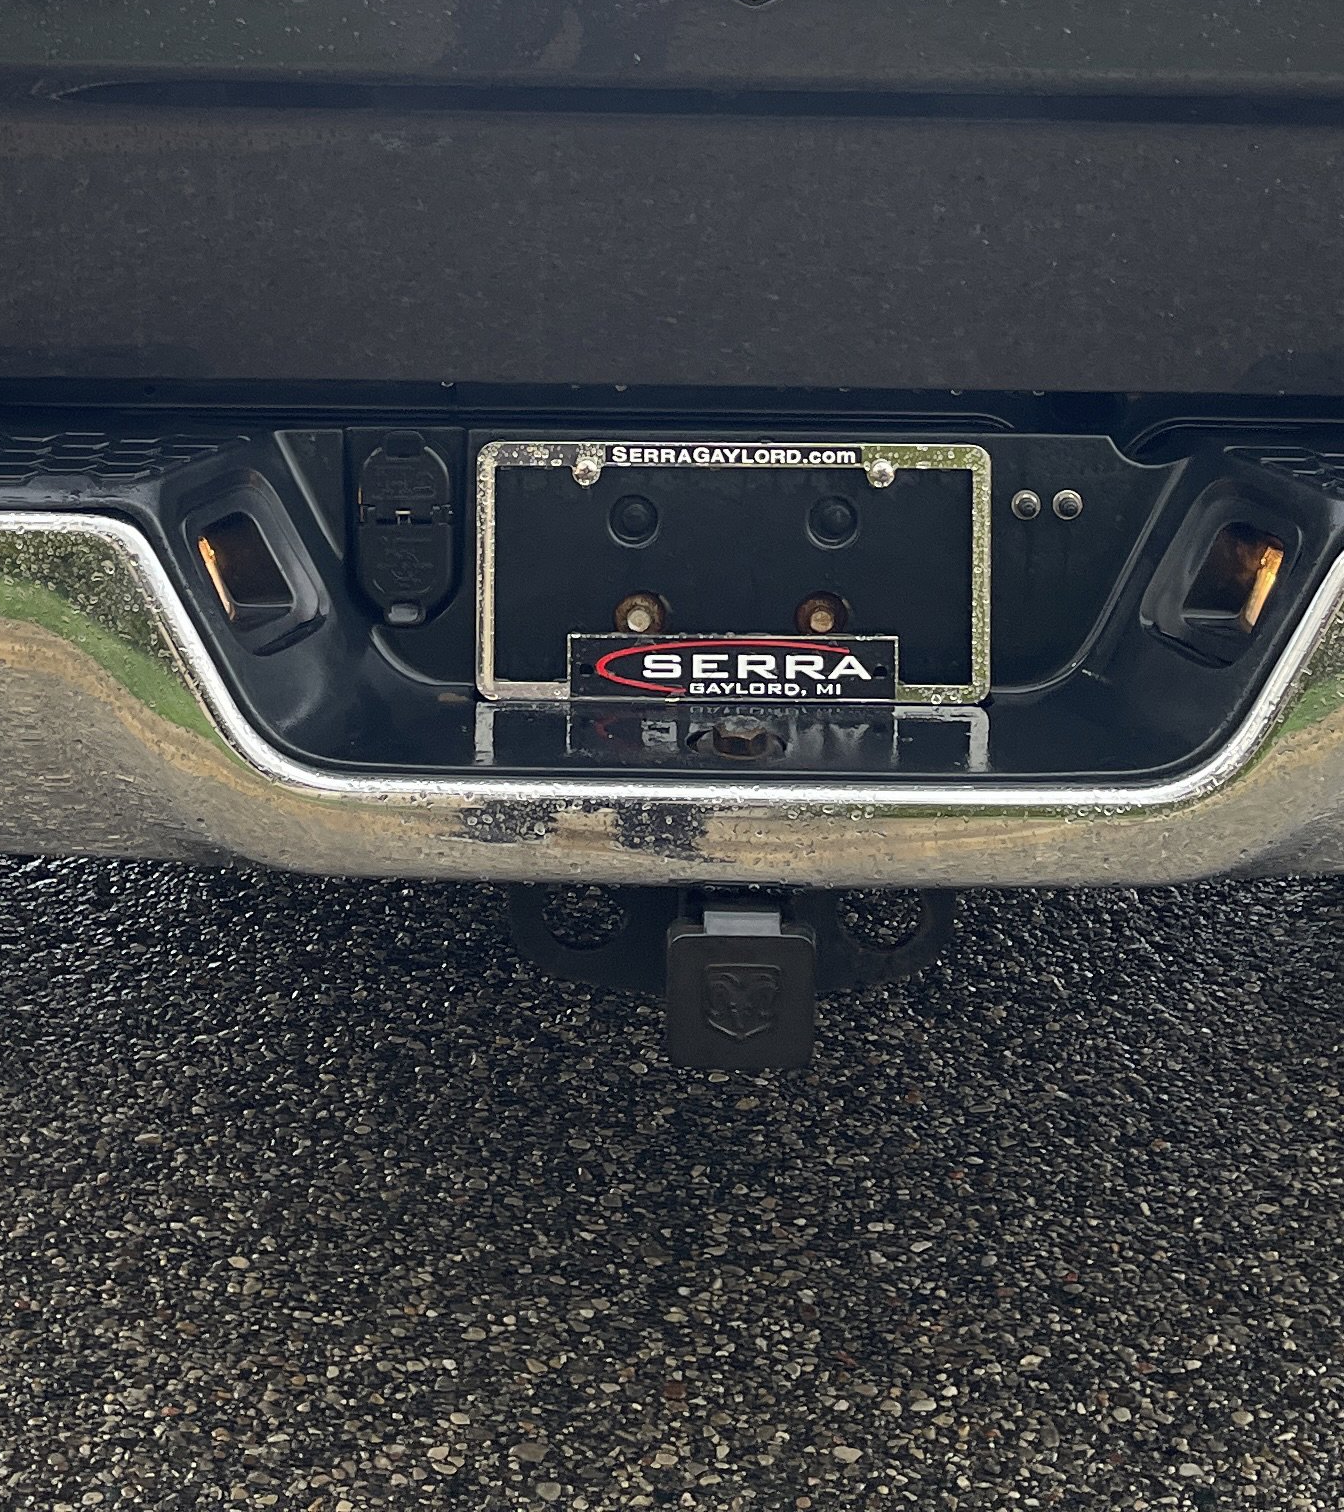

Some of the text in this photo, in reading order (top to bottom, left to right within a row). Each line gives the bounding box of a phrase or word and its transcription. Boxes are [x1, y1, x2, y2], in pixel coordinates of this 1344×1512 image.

[642, 654, 872, 680] SERRA
[689, 683, 841, 697] GAYLORD, MI
